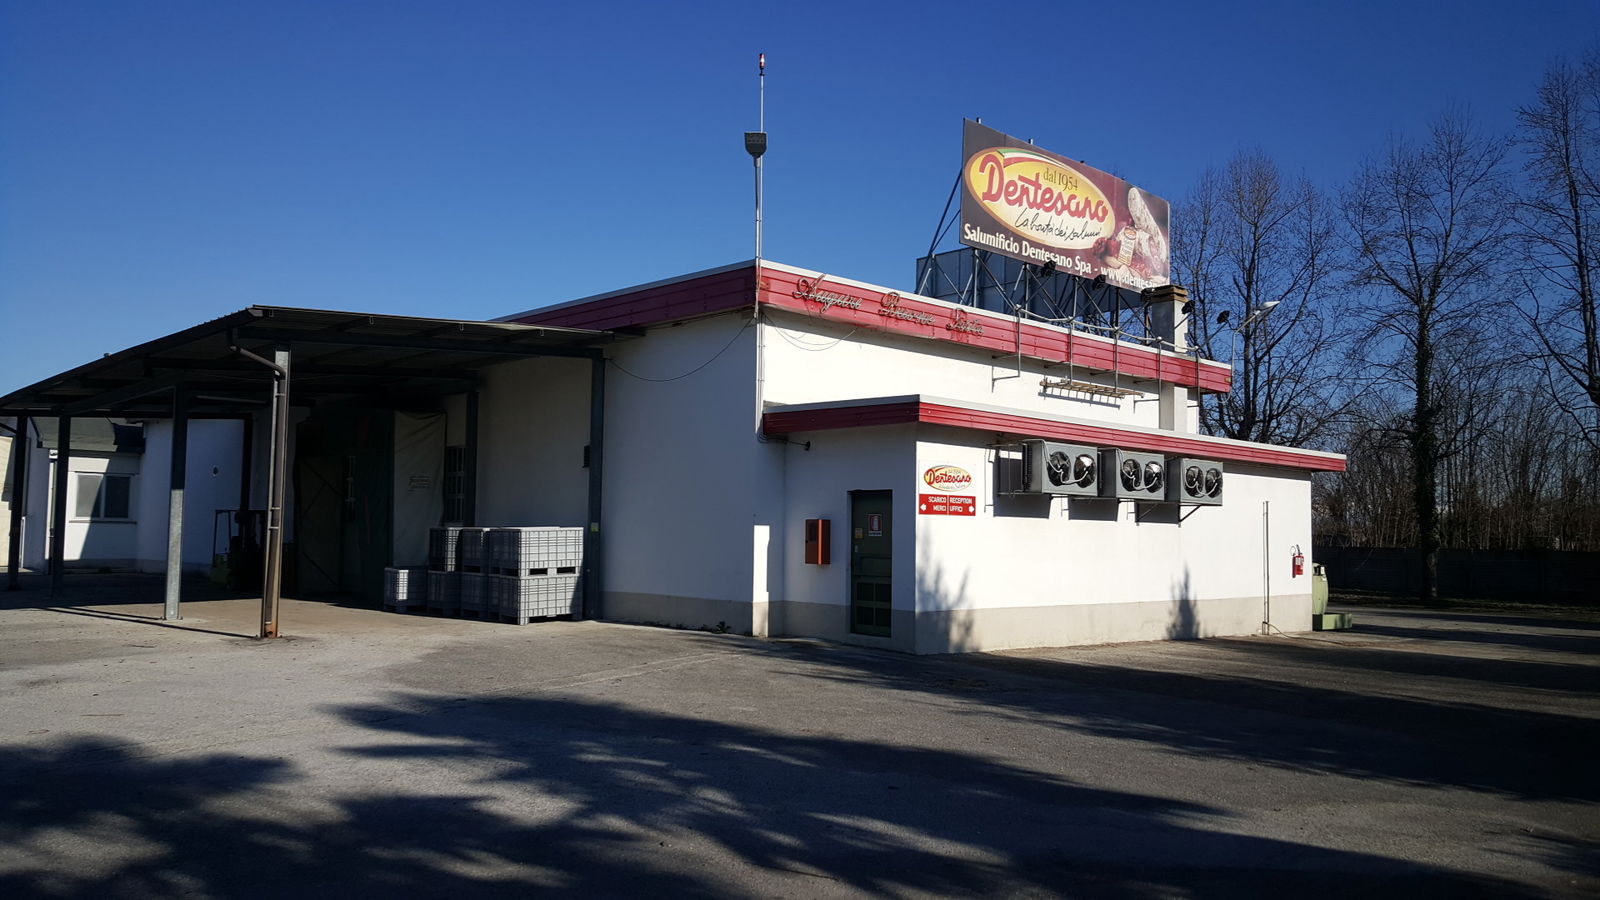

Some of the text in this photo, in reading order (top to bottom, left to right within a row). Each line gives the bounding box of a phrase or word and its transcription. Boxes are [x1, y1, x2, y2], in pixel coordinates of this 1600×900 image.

[979, 153, 1109, 223] Dentesano
[1043, 167, 1079, 191] dal 1954
[964, 223, 1020, 254] Salumificio
[1021, 240, 1073, 268] Dentesano
[1074, 255, 1092, 275] Spa
[926, 469, 972, 485] Dentesano
